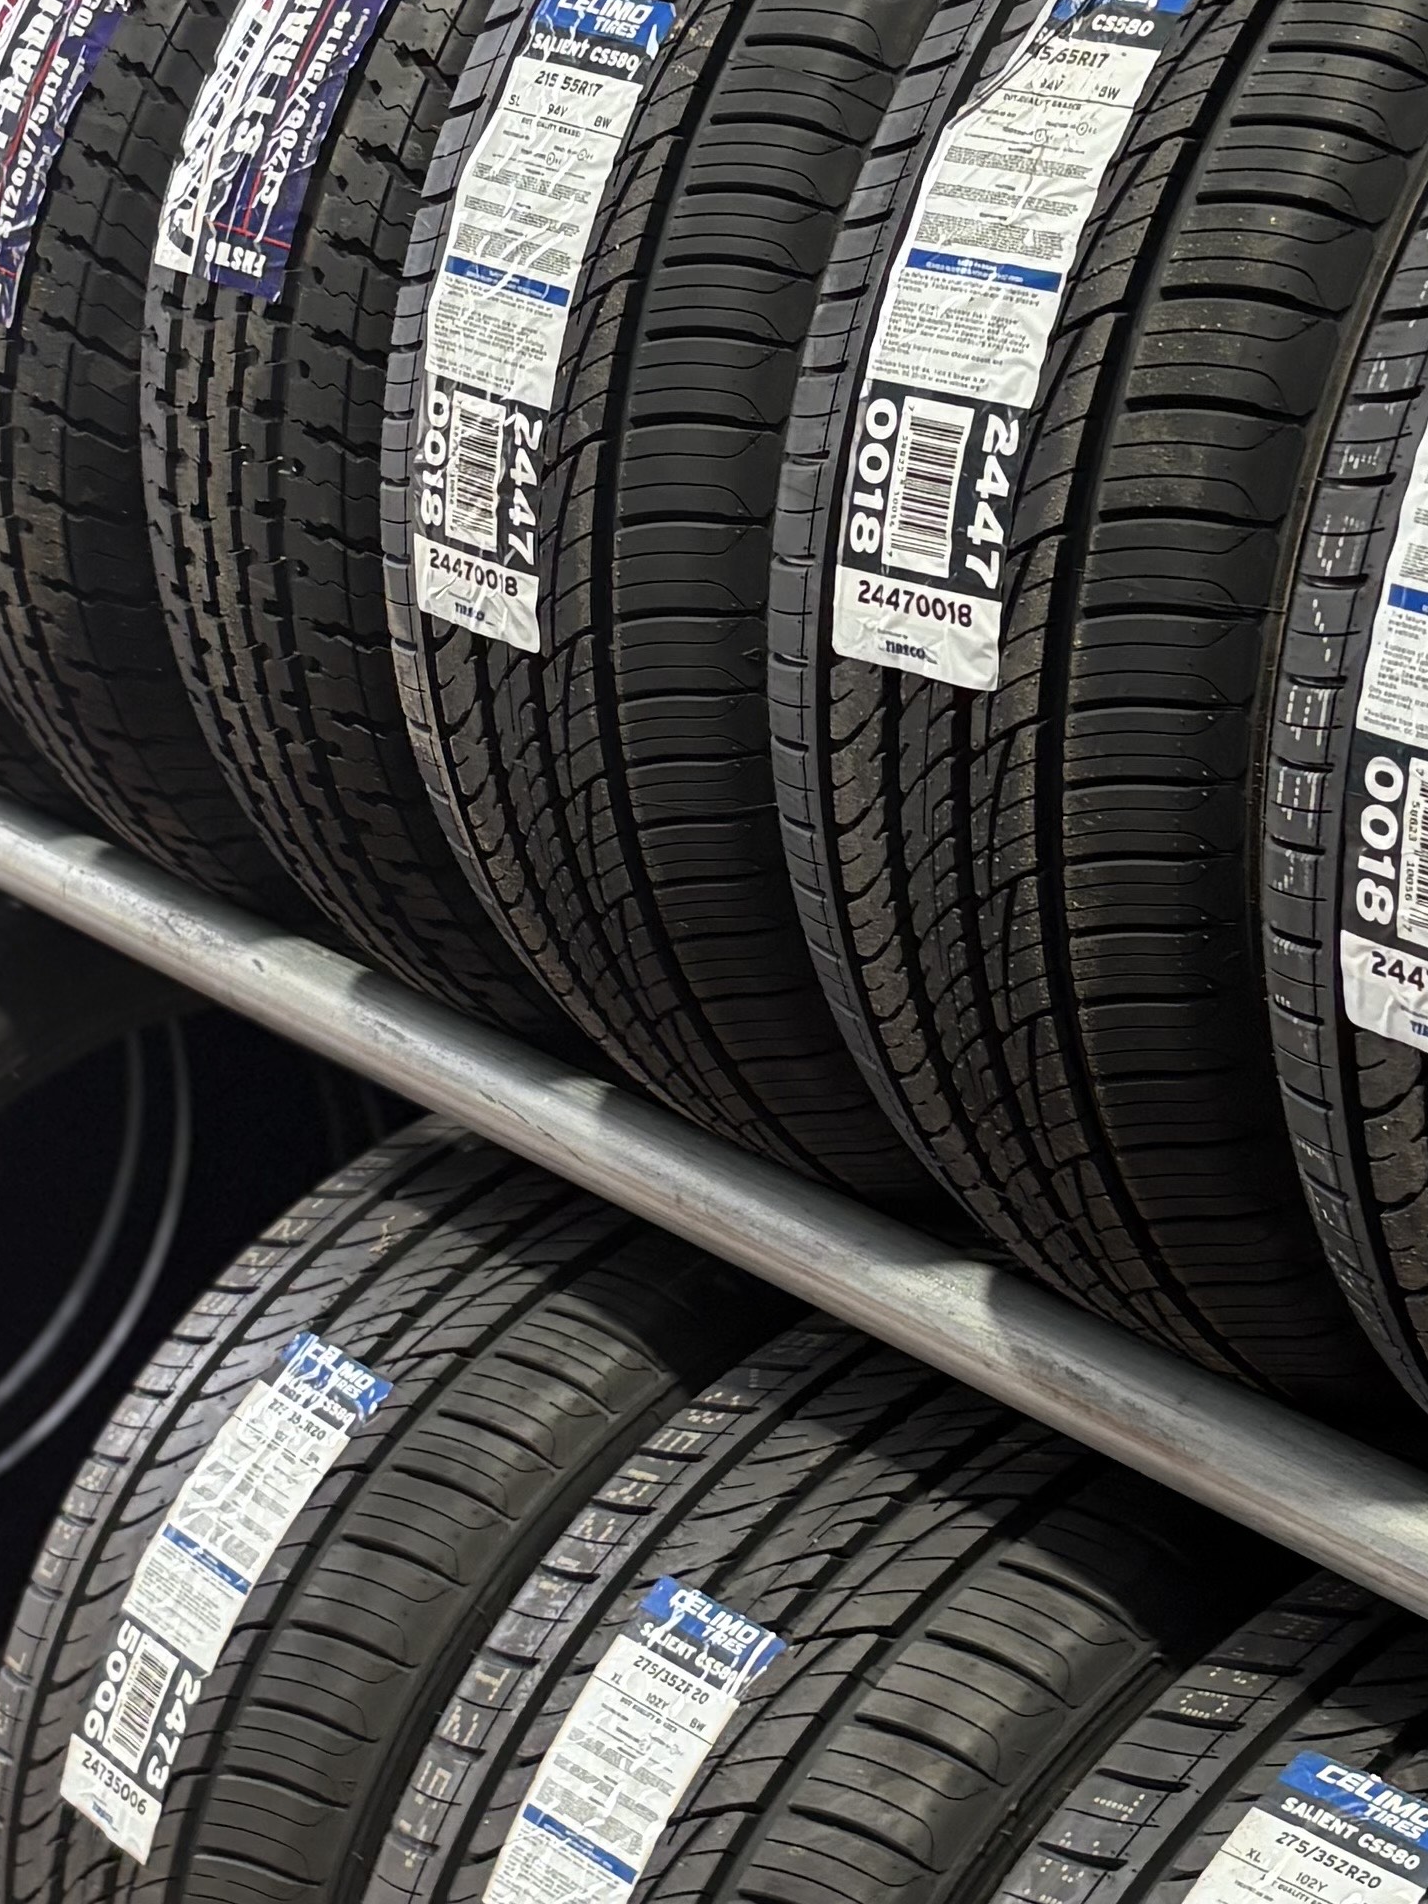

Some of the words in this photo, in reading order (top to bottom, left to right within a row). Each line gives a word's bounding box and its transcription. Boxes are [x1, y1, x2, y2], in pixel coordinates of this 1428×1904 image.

[532, 33, 591, 59] SALIENT
[590, 46, 641, 70] CS580
[594, 17, 640, 39] TIRES
[1091, 14, 1155, 36] CS580
[594, 116, 612, 129] BW
[420, 388, 449, 527] 0018
[502, 401, 543, 566] 2447
[849, 398, 899, 556] 0018
[964, 412, 1021, 590] 2447
[428, 548, 519, 597] 24470018
[857, 579, 974, 627] 24470018
[1356, 756, 1404, 925] 0018
[670, 1589, 759, 1644] CELIMO
[702, 1626, 747, 1655] TIRES
[84, 1619, 142, 1744] 5006
[146, 1670, 201, 1789] 2473
[81, 1750, 147, 1815] 24735006
[1281, 1796, 1359, 1840] SALIENT
[1357, 1833, 1420, 1871] CS580
[1364, 1804, 1426, 1842] TIRES
[1245, 1848, 1261, 1864] XL
[1295, 1871, 1328, 1893] 102Y
[1275, 1832, 1381, 1890] 275/35ZR20
